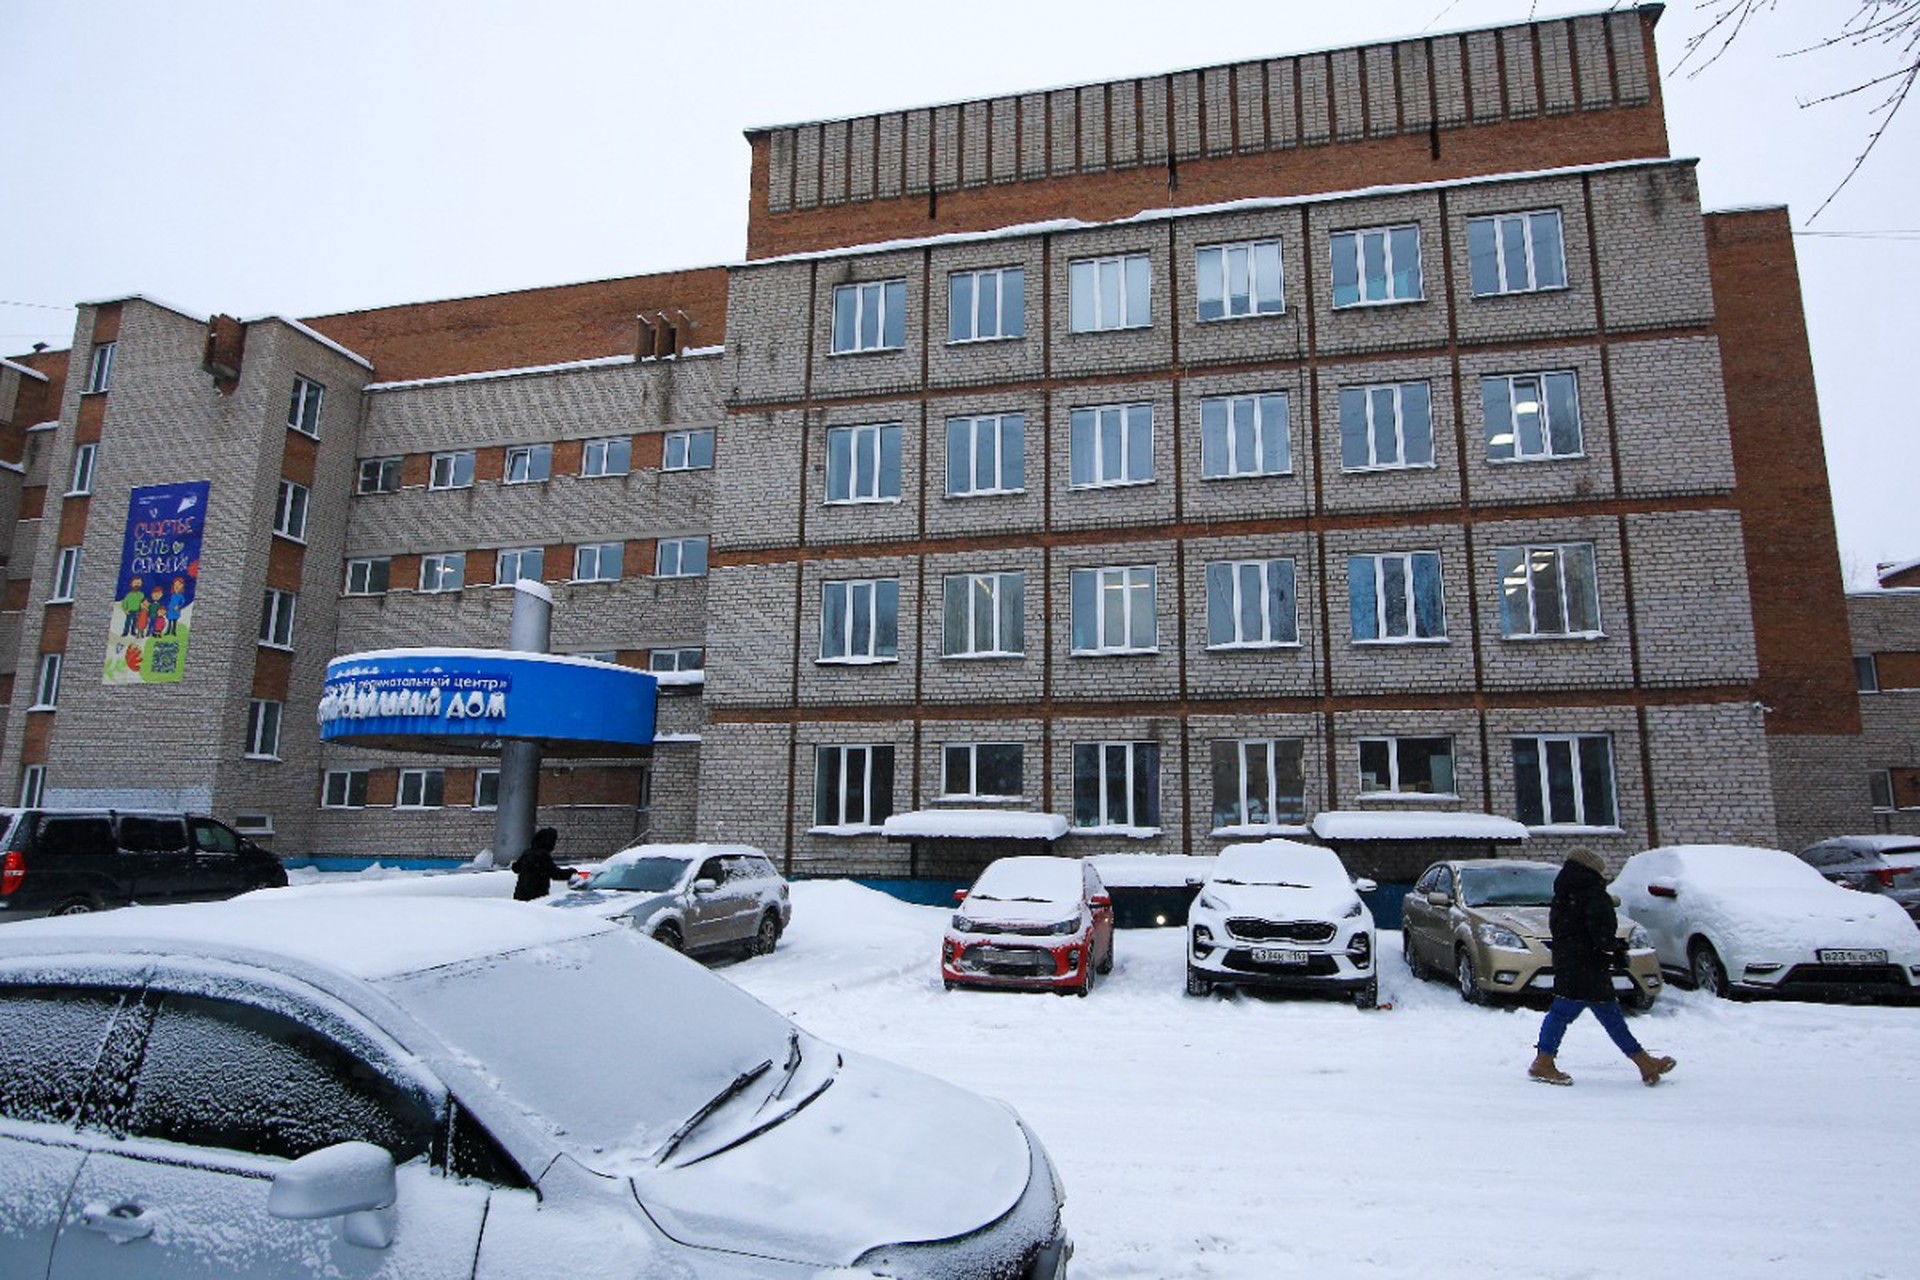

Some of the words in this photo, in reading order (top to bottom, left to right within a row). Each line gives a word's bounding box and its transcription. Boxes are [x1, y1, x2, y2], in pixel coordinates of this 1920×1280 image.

[134, 516, 196, 539] СЧАСТЬЕ
[134, 538, 170, 557] БЫТЬ
[445, 690, 506, 719] ДОМ
